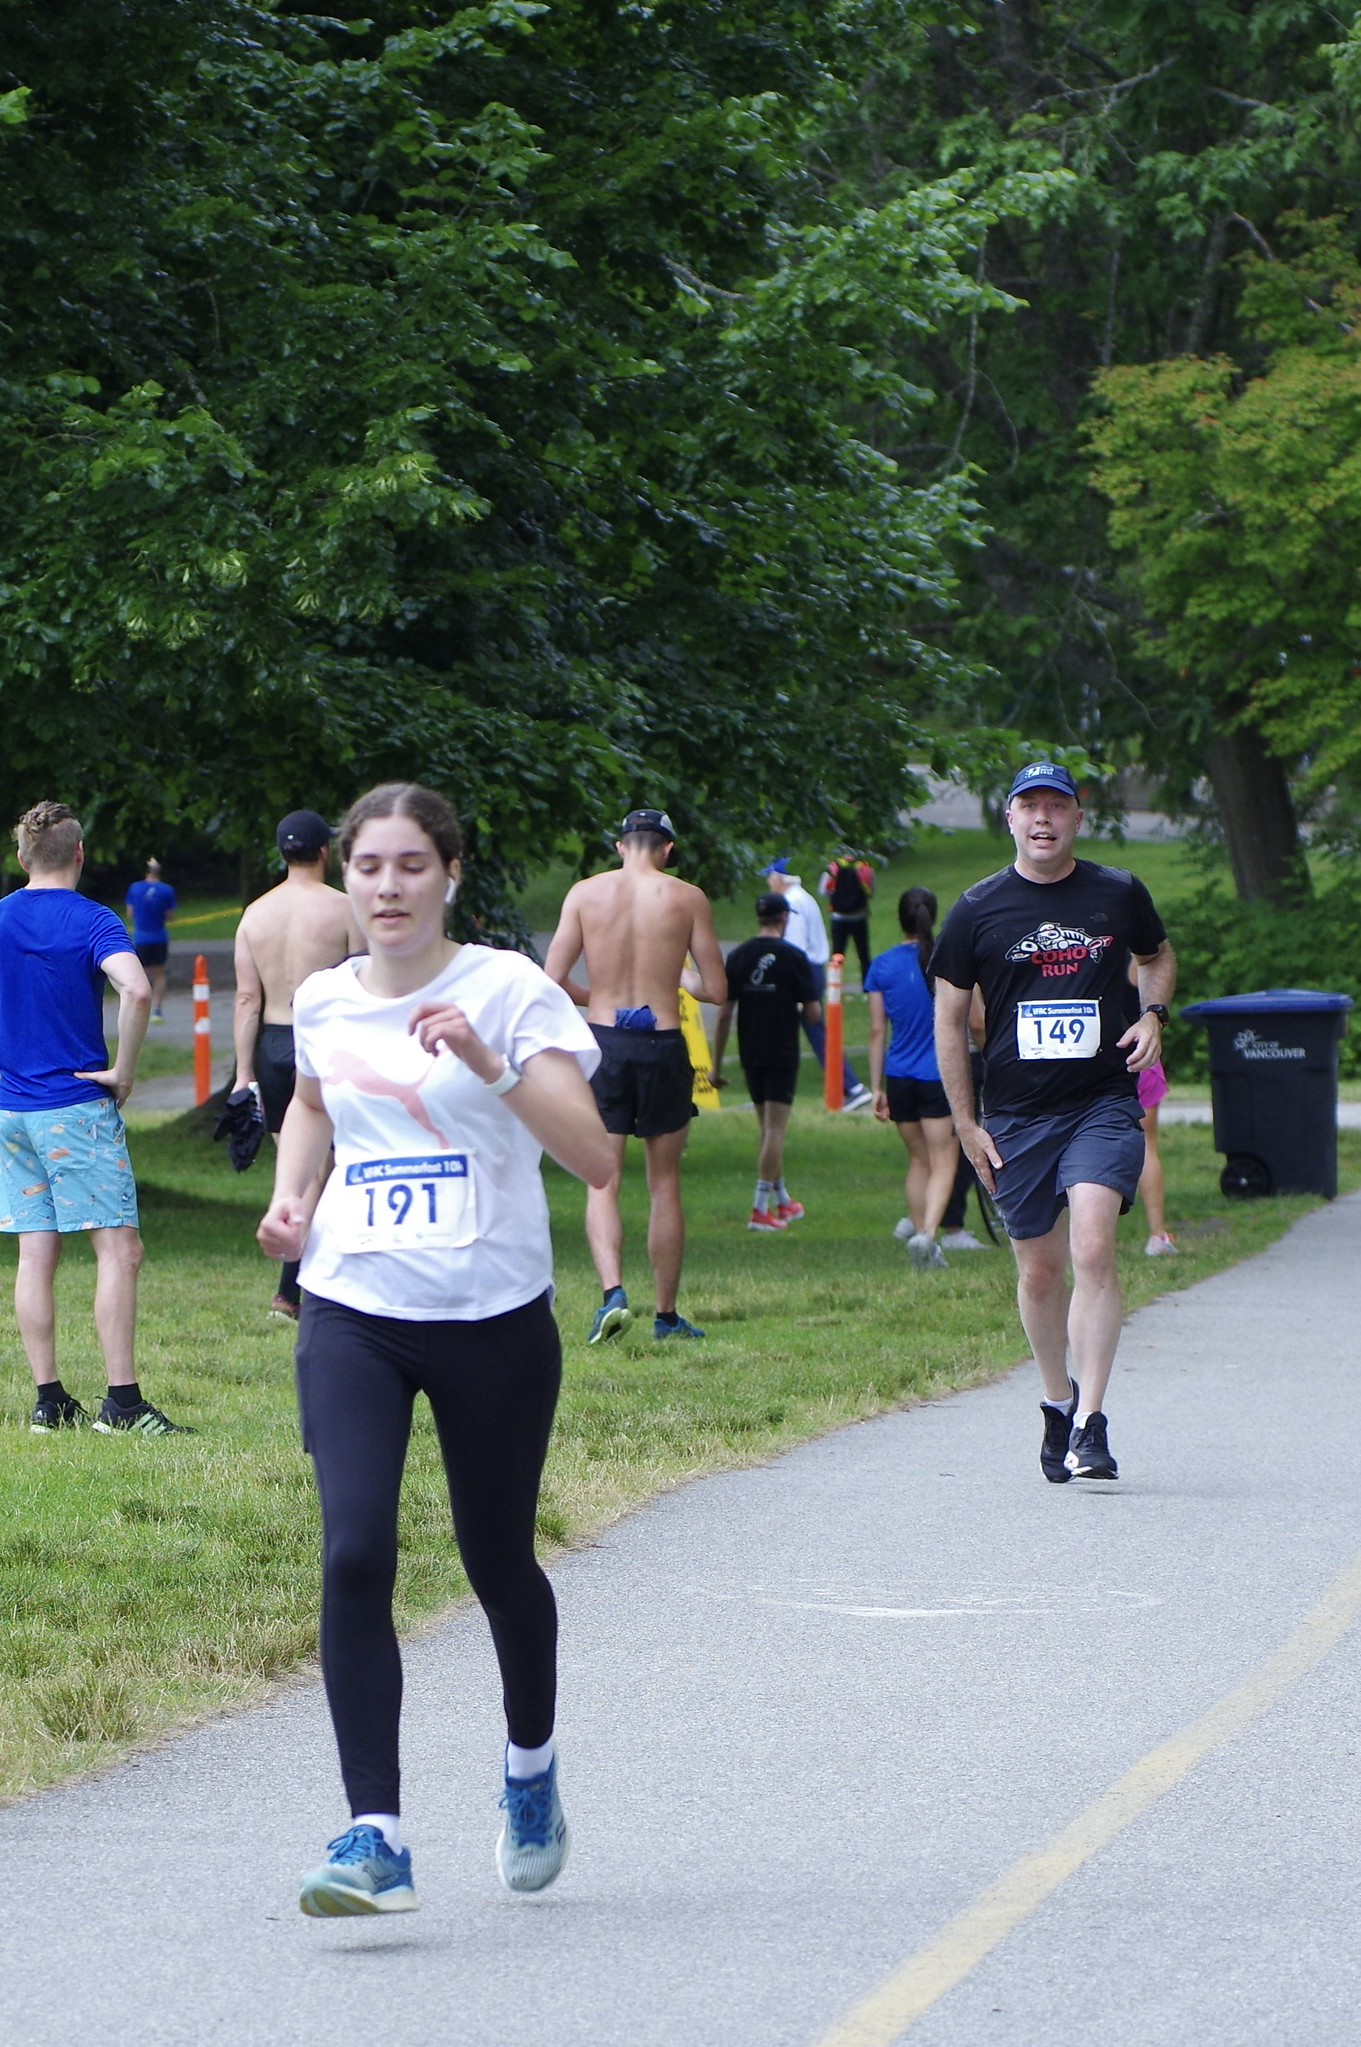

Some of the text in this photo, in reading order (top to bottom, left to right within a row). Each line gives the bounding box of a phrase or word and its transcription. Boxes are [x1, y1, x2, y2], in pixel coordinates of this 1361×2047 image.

[1031, 947, 1088, 963] COHO
[1042, 963, 1078, 977] RUN
[1033, 1019, 1085, 1044] 149
[1244, 1047, 1306, 1058] VANCOUVER
[365, 1183, 437, 1227] 191
